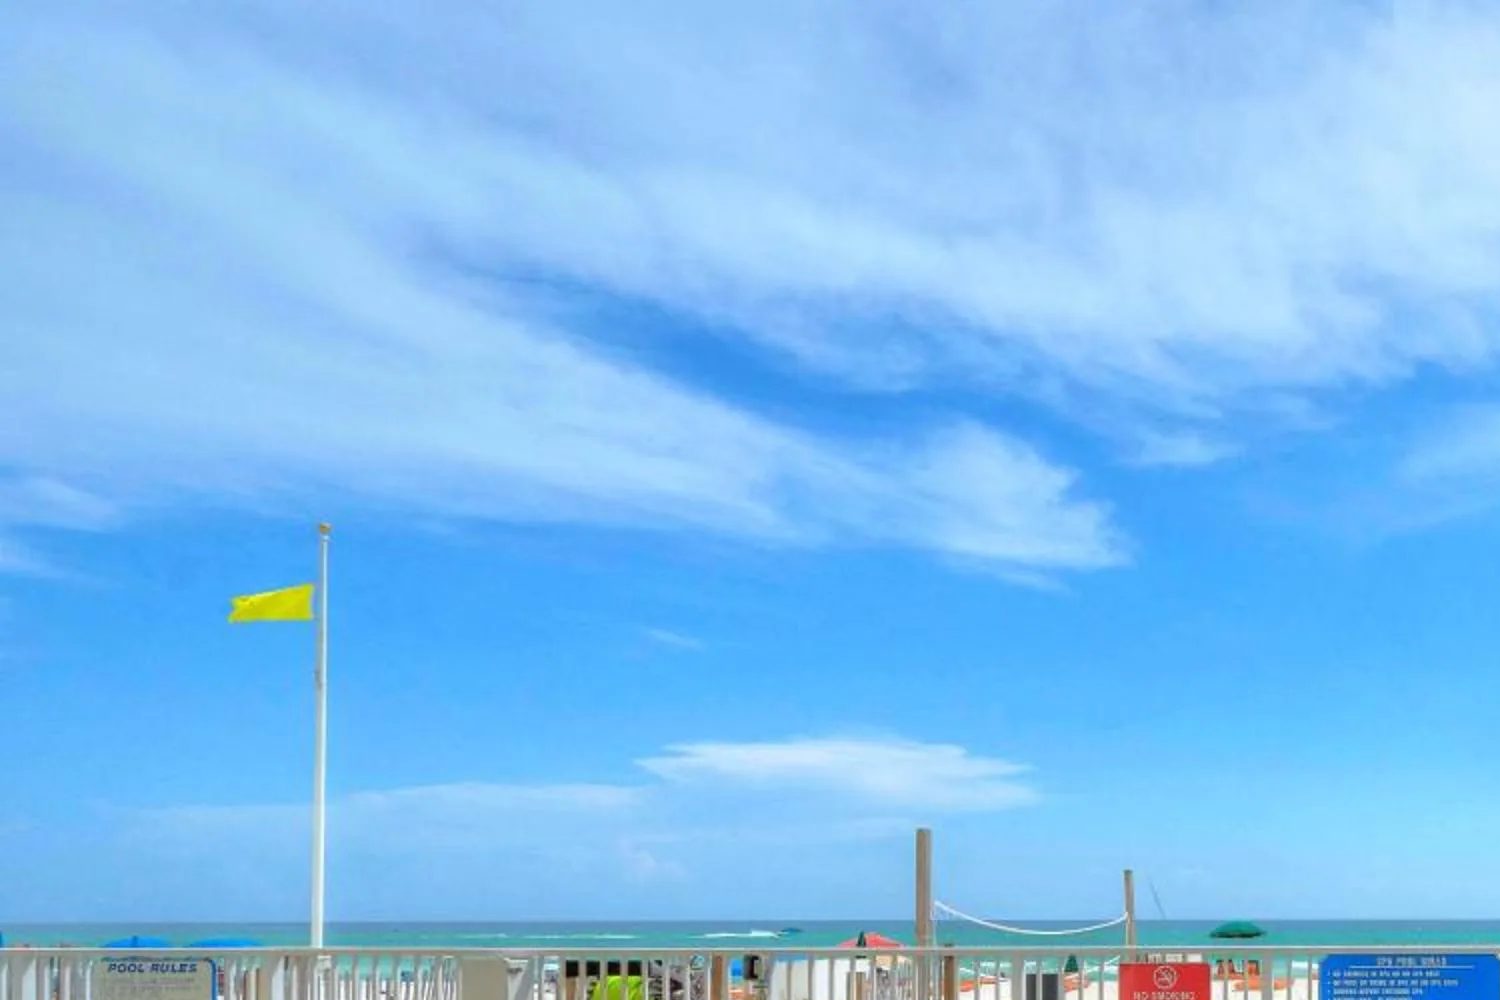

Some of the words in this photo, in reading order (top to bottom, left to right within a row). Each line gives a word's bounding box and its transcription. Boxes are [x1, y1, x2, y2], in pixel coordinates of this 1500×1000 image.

[108, 963, 145, 973] POOL
[151, 963, 197, 973] RULES
[1133, 991, 1149, 1000] NO
